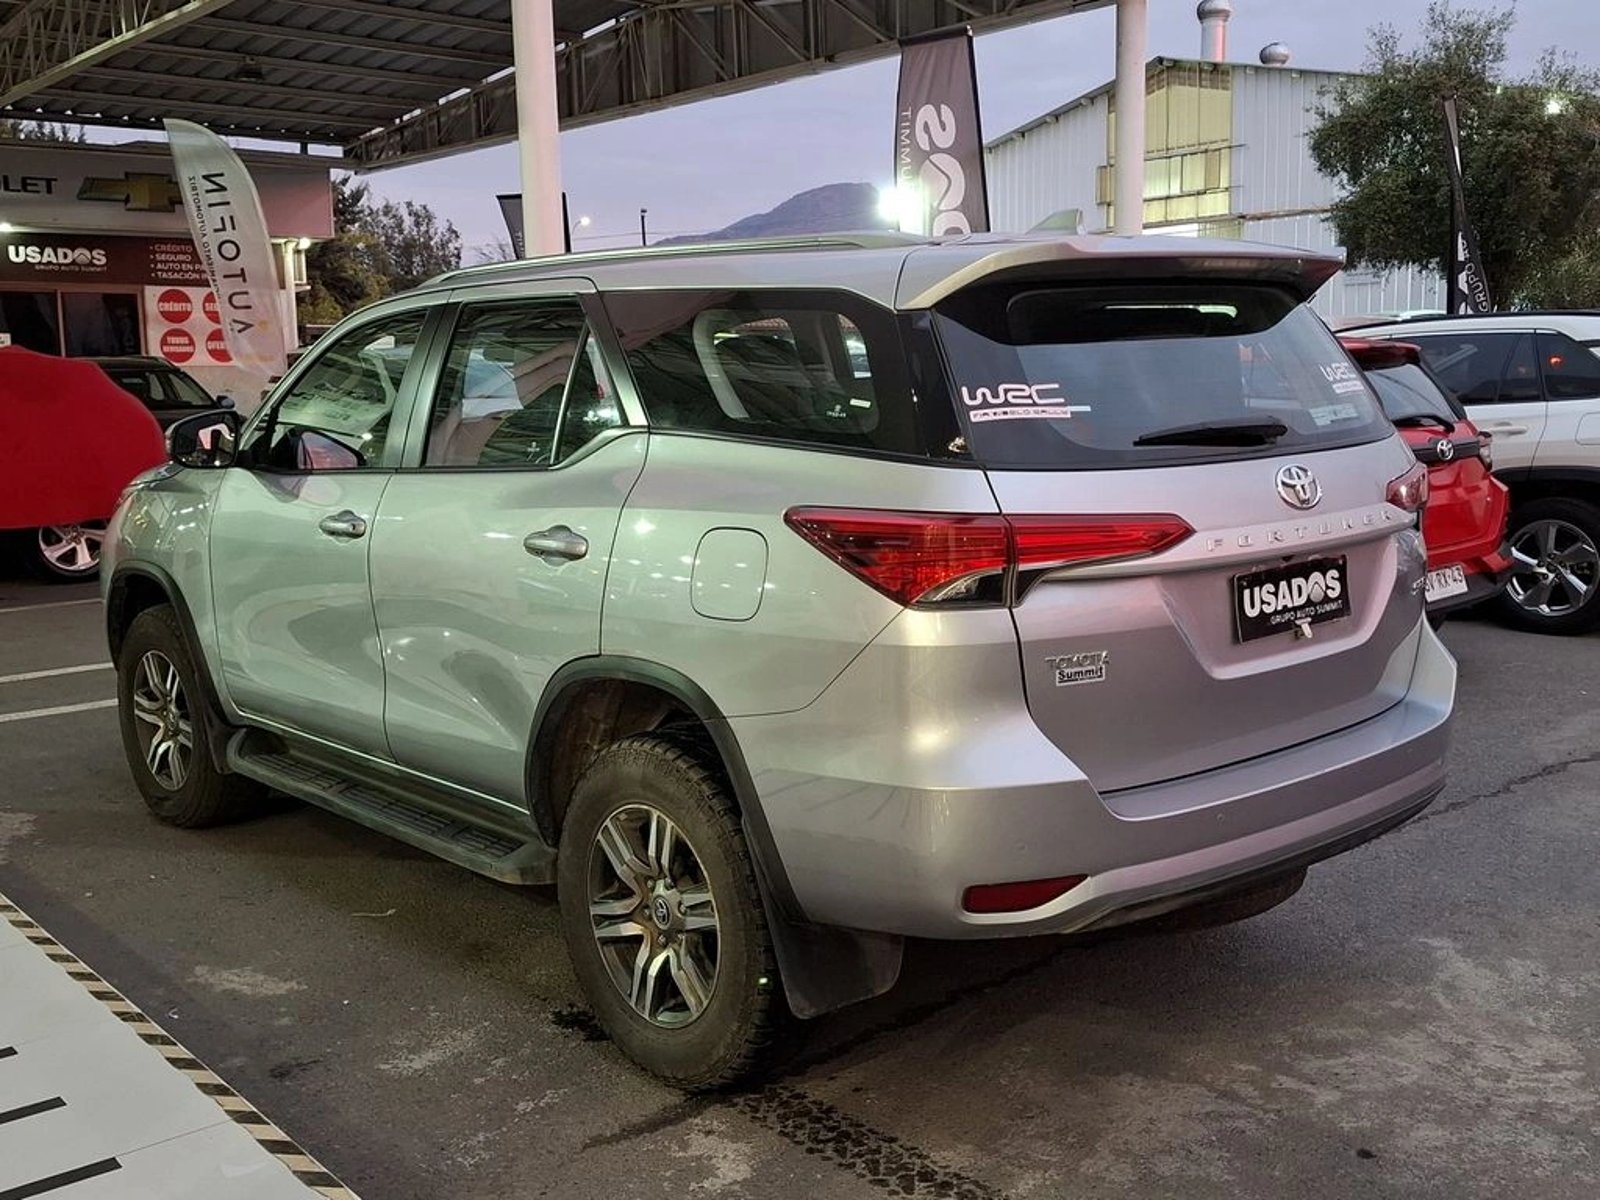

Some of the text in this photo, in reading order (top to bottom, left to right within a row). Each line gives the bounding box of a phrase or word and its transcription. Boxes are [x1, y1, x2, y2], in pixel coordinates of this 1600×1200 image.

[8, 244, 107, 266] USADOS
[155, 253, 192, 262] SEGURO
[156, 262, 181, 271] AUTO
[1465, 263, 1489, 312] GRUPO
[961, 383, 1065, 405] WRC
[1206, 510, 1394, 552] FORTUNER
[1243, 569, 1342, 618] USADOS
[1270, 599, 1343, 625] GRUPO AUTO SUMMIT
[1058, 666, 1103, 681] Summit
